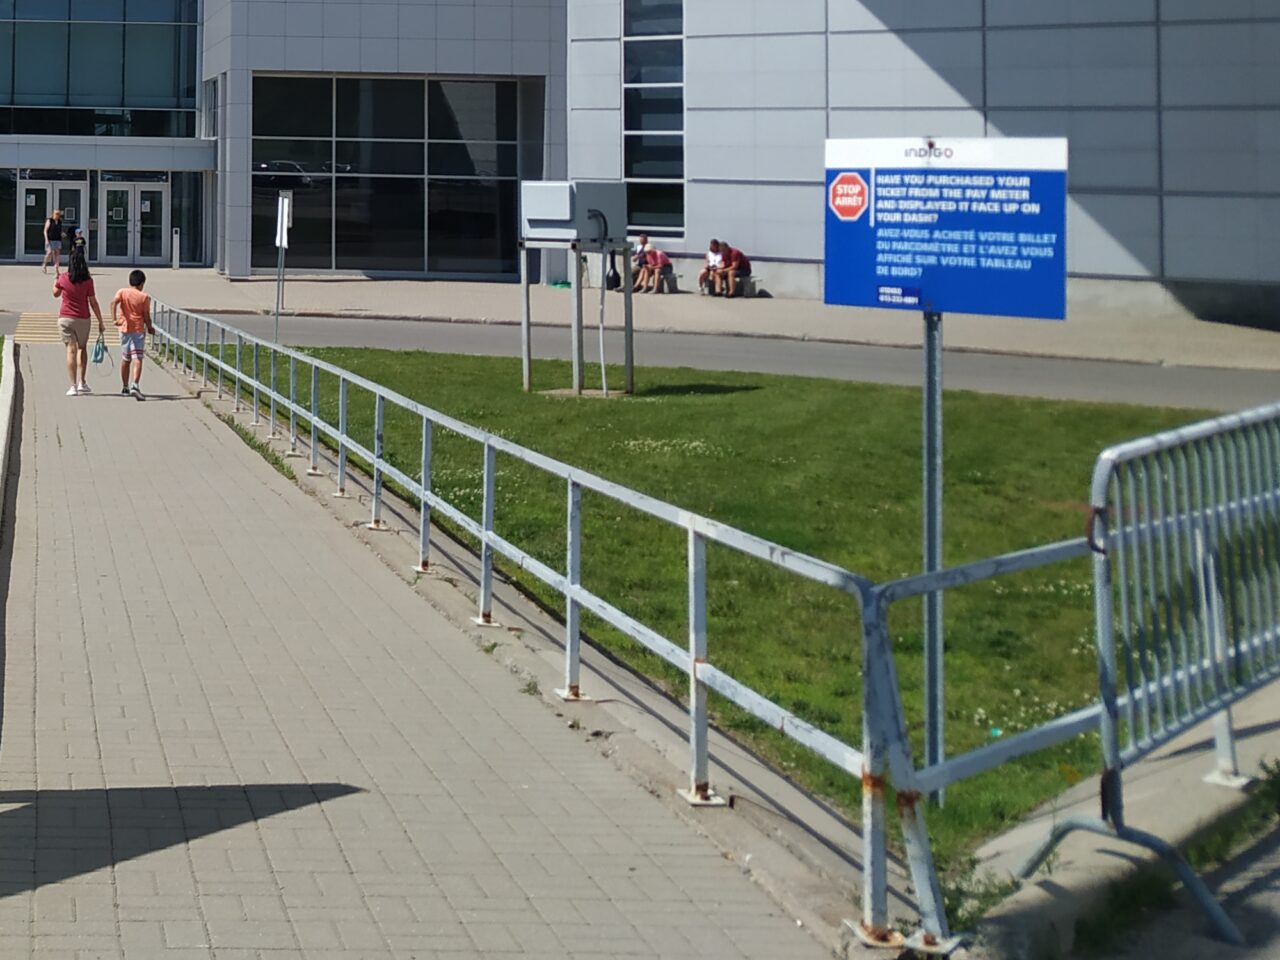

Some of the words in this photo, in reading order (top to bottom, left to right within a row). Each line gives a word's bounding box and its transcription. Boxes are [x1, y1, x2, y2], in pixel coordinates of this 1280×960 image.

[876, 174, 901, 185] HAVE
[902, 175, 924, 186] YOU
[926, 175, 994, 187] PURCHASED
[997, 176, 1030, 187] YOUR
[835, 184, 862, 195] STOP
[876, 187, 907, 198] TICKET
[908, 187, 940, 198] FROM
[941, 188, 963, 199] THE
[965, 189, 988, 200] PAY
[991, 189, 1030, 200] METER
[835, 195, 863, 206] ARRÊT
[876, 200, 897, 210] AND
[898, 200, 956, 212] DISPLAYED
[958, 201, 969, 212] IT
[971, 202, 1001, 213] FACE
[1003, 202, 1021, 213] UP
[1022, 203, 1040, 214] ON
[876, 212, 902, 222] YOUR
[903, 212, 938, 223] DASH?
[876, 228, 930, 239] AVEZ-VOUS
[932, 229, 975, 241] ACHETÉ
[978, 231, 1015, 243] VOTRE
[1018, 233, 1057, 244] BILLET
[876, 241, 891, 251] DU
[892, 241, 959, 253] PARCOMÈTRE
[962, 244, 976, 254] ET
[979, 244, 1018, 256] L'AVEZ
[1021, 246, 1055, 258] VOUS
[876, 253, 913, 264] AFFICHÉ
[914, 255, 938, 265] SUR
[940, 256, 976, 267] VOTRE
[979, 257, 1032, 270] TABLEAU
[876, 265, 890, 276] DE
[891, 266, 923, 277] BORD?
